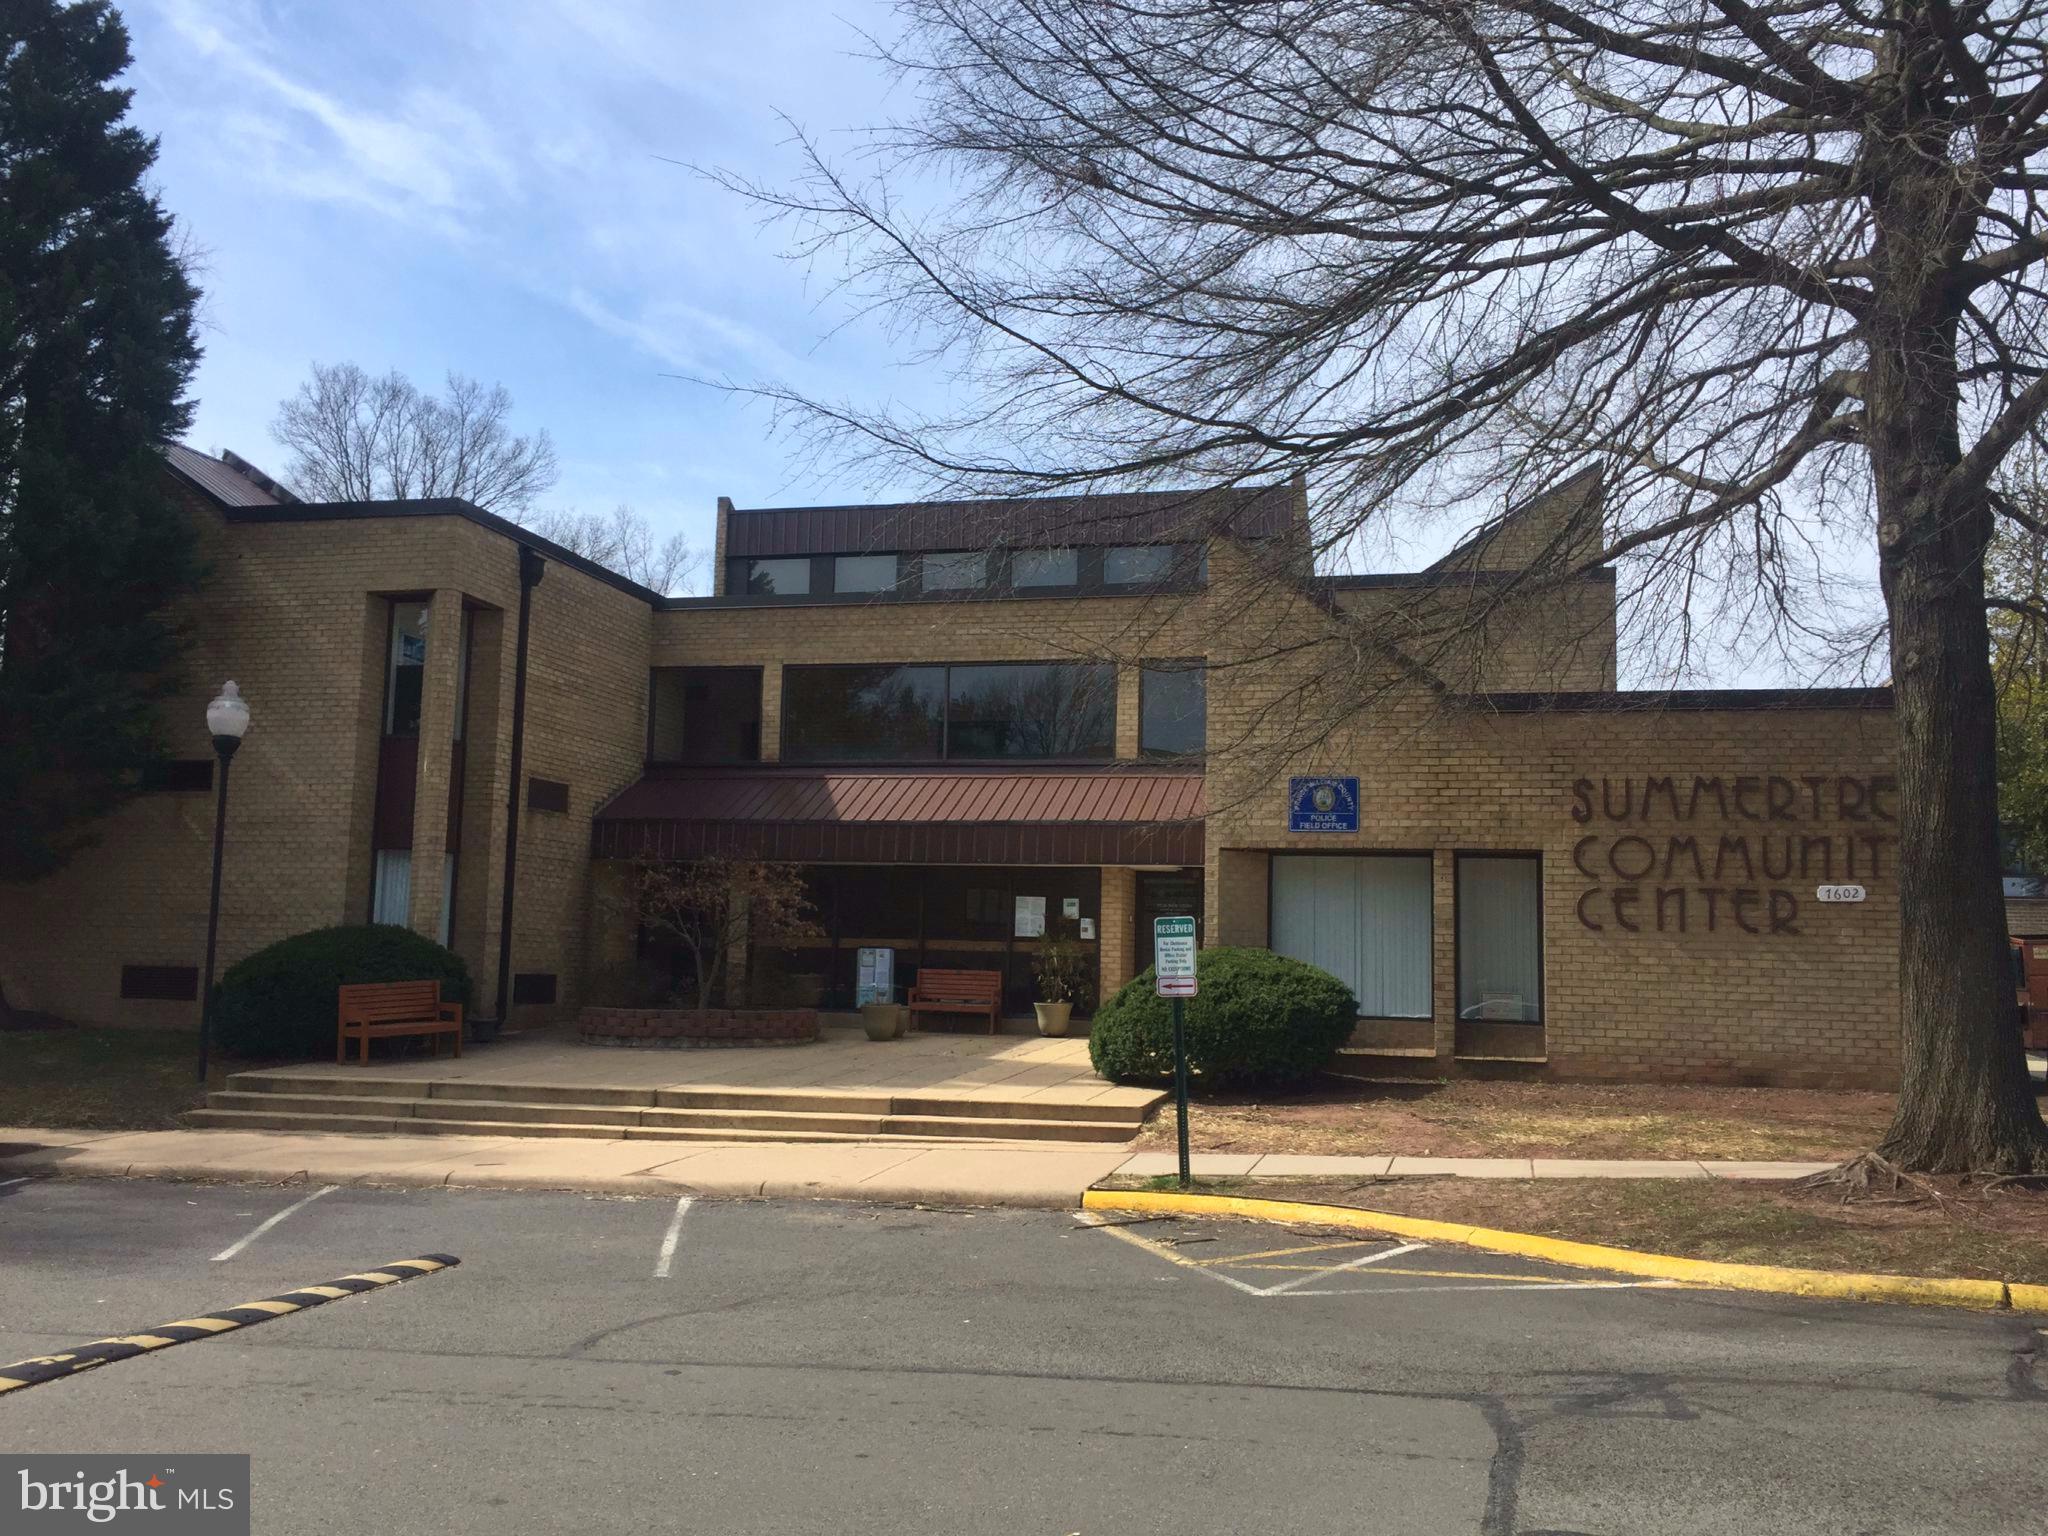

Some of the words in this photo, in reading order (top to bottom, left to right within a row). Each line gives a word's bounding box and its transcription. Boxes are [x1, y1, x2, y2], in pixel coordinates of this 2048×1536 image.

[1337, 783, 1355, 811] COUNTY
[1571, 775, 1899, 823] SUMMERTRE
[1310, 814, 1337, 822] POLICE
[1572, 833, 1899, 880] COMMUNIT
[1825, 888, 1859, 900] 1602
[1576, 887, 1800, 934] CENTER
[1157, 924, 1193, 934] RESERVED
